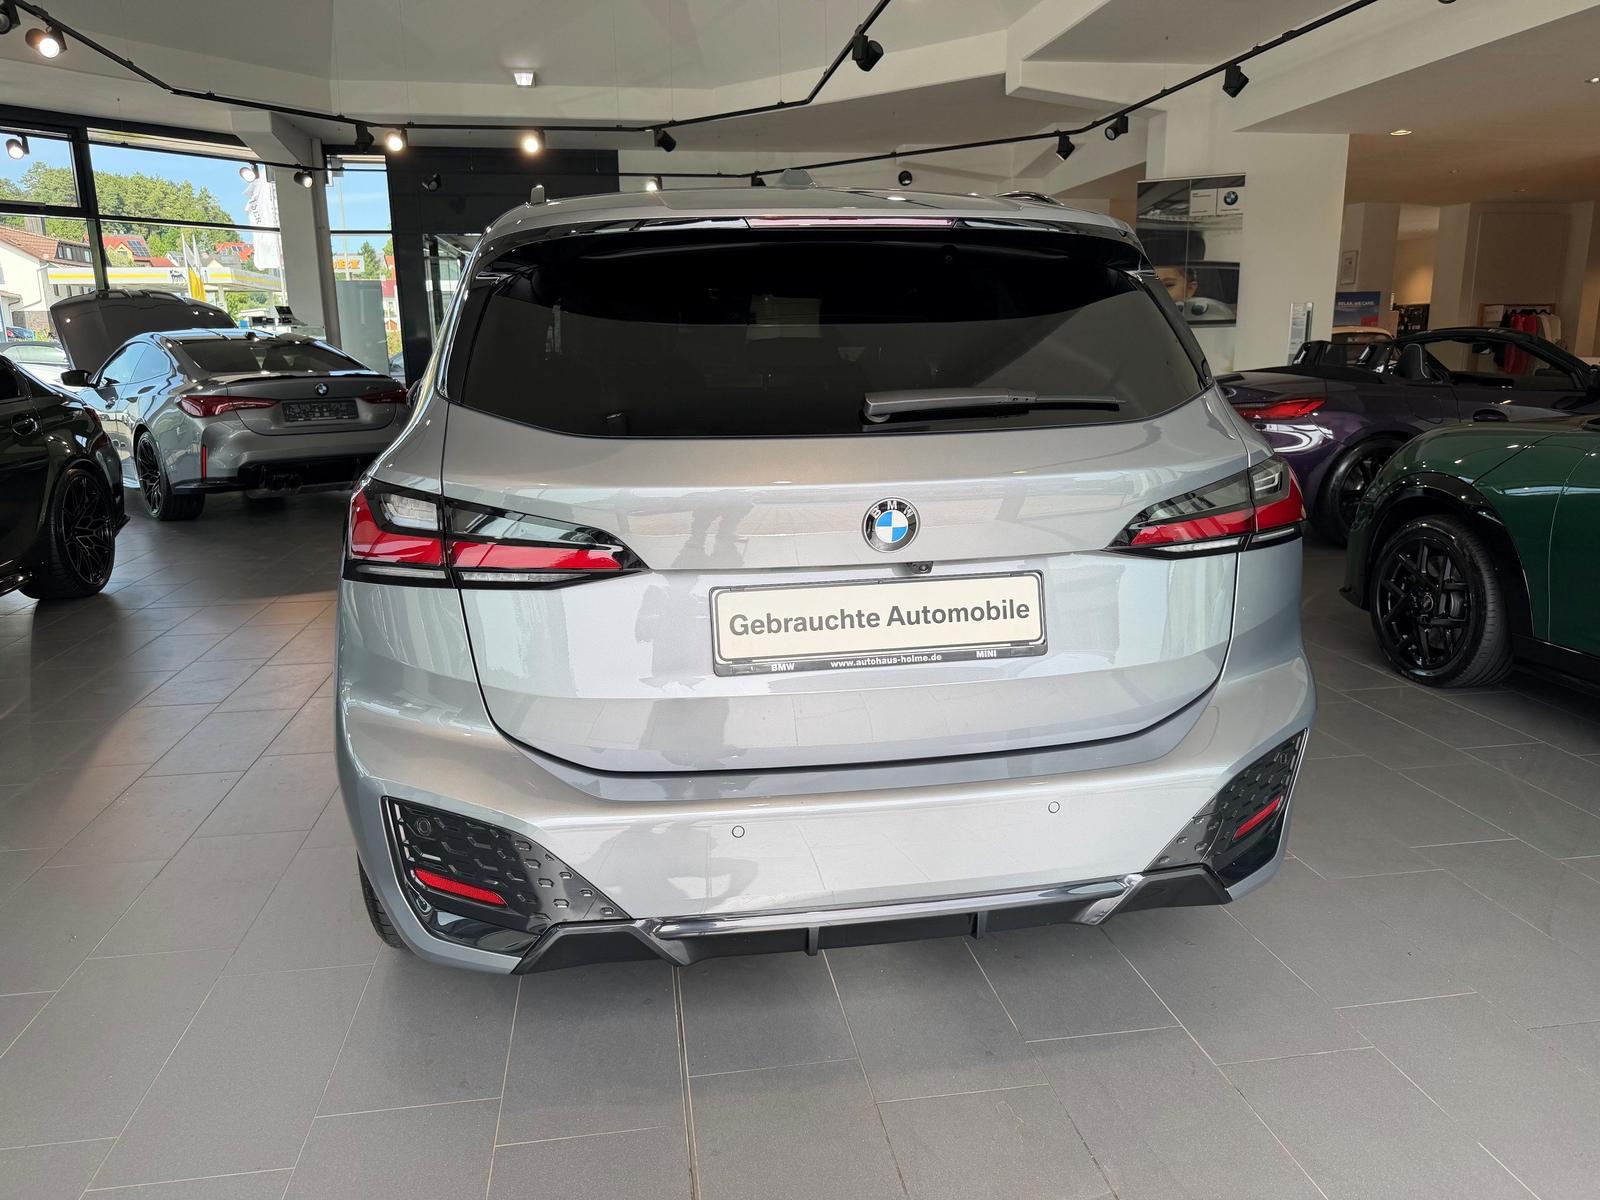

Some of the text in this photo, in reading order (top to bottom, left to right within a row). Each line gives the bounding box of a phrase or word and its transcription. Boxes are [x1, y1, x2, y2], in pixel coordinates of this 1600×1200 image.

[869, 500, 914, 519] BMW
[729, 599, 1030, 636] Gebrauchte Automobile
[771, 649, 998, 672] BMW www.autohaus-holme.de MINI
